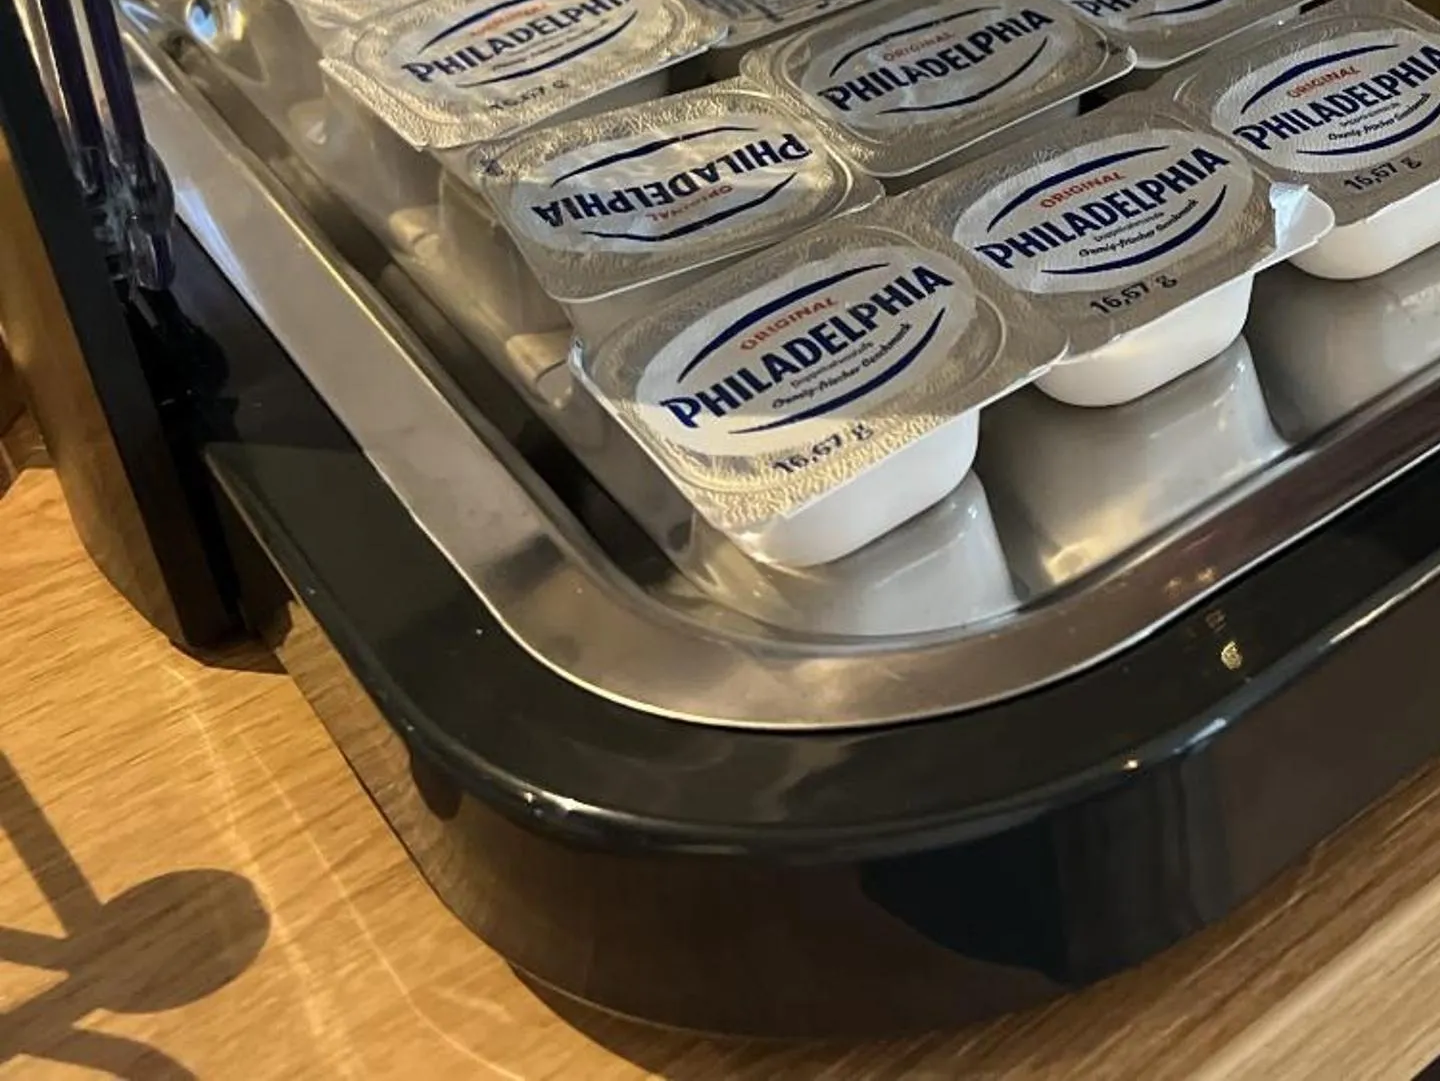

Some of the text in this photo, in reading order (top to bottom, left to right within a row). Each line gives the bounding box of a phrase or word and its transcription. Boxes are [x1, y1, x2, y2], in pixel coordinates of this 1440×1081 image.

[817, 8, 1055, 111] PHILADELPHIA
[531, 133, 813, 228] PHILADELPHIA
[1040, 171, 1128, 209] ORIGINAL
[1344, 161, 1399, 193] 16,67
[974, 148, 1231, 269] PHILADELPHIA
[740, 297, 840, 351] ORIGINAL
[1090, 280, 1150, 315] 16,67
[659, 265, 955, 428] PHILADELPHIA
[772, 432, 844, 474] 16,67
